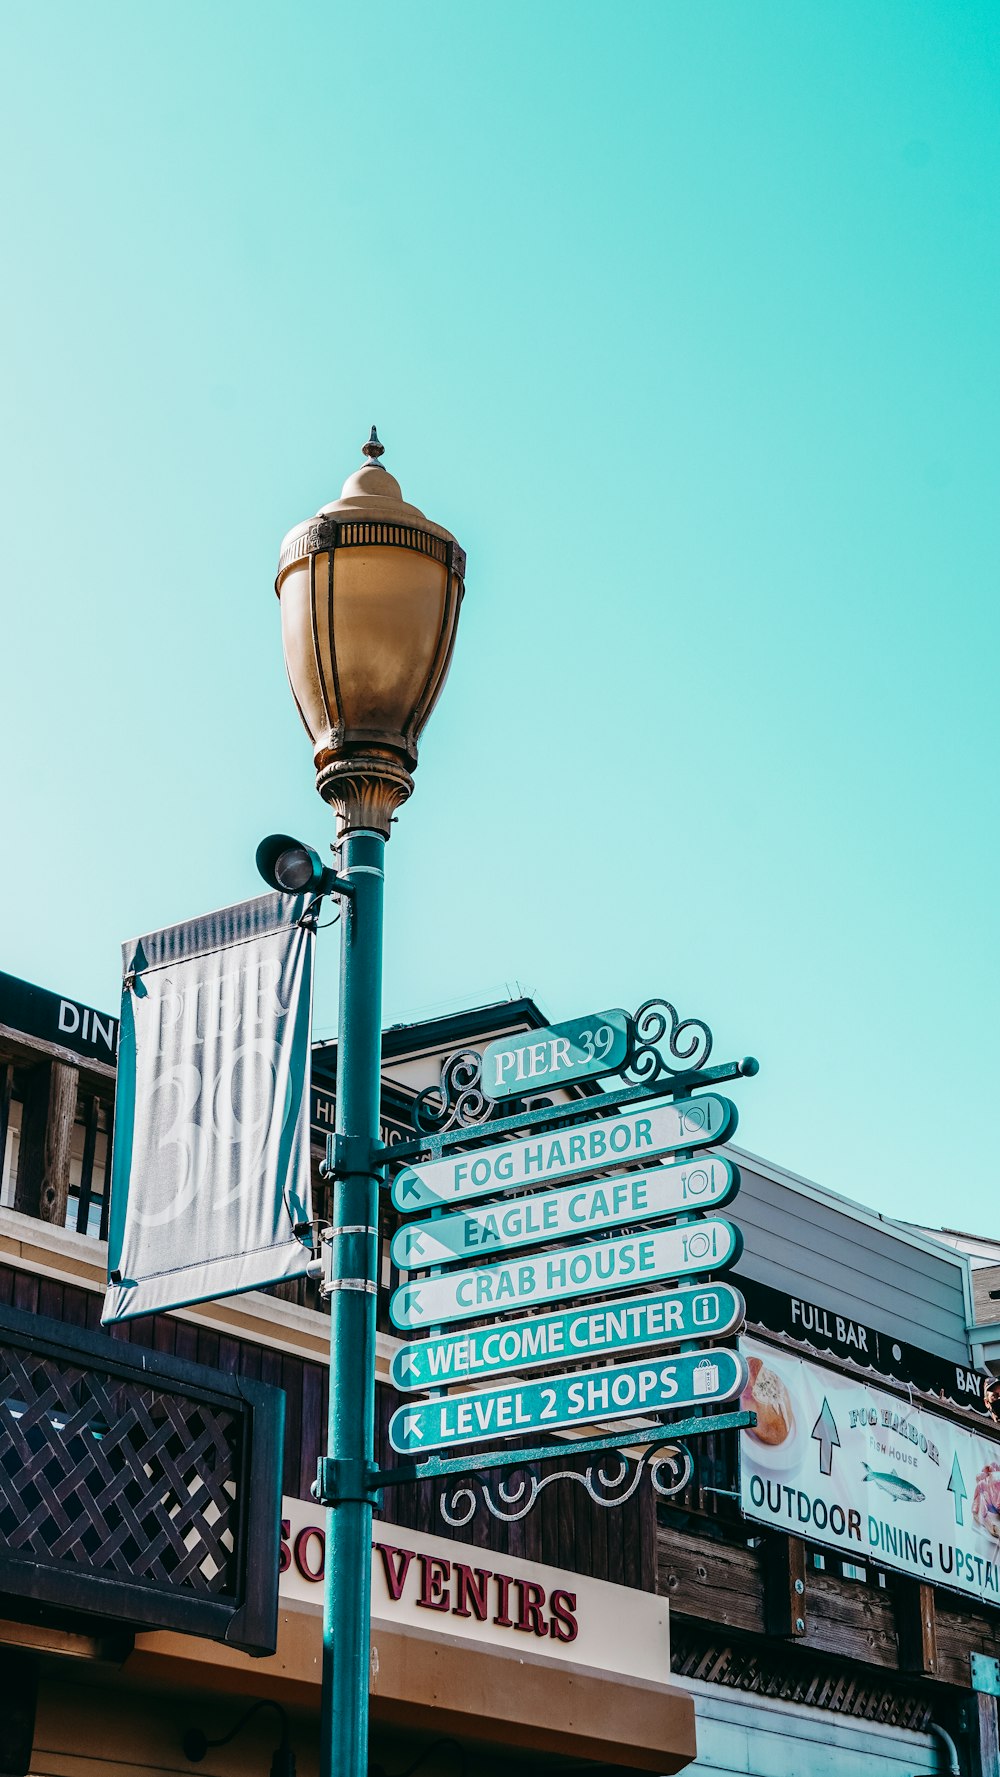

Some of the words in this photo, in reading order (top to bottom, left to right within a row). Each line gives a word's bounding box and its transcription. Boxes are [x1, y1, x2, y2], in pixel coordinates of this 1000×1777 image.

[154, 958, 290, 1057] PIER
[494, 1037, 575, 1086] PIER
[577, 1025, 615, 1064] 39
[131, 1037, 292, 1227] 39
[454, 1152, 514, 1191] FOG
[524, 1118, 653, 1174] HARBOR
[464, 1199, 558, 1247] EAGLE
[568, 1180, 648, 1223] CAFE
[455, 1266, 536, 1307] CRAB
[546, 1240, 655, 1290] HOUSE
[427, 1323, 563, 1376] WELCOME
[568, 1299, 684, 1348] CENTER
[791, 1298, 833, 1338] FULL
[835, 1316, 869, 1352] BAR
[955, 1367, 981, 1397] BAY
[440, 1393, 531, 1437] LEVEL
[540, 1388, 557, 1419] 2
[567, 1366, 679, 1414] SHOPS
[848, 1408, 878, 1429] FOG
[881, 1408, 940, 1467] HARBOR
[888, 1444, 918, 1468] HOUSE
[750, 1475, 862, 1542] OUTDOOR
[867, 1514, 933, 1568] DINING
[938, 1543, 999, 1593] UPSTAI
[279, 1518, 579, 1643] OVENIRS
